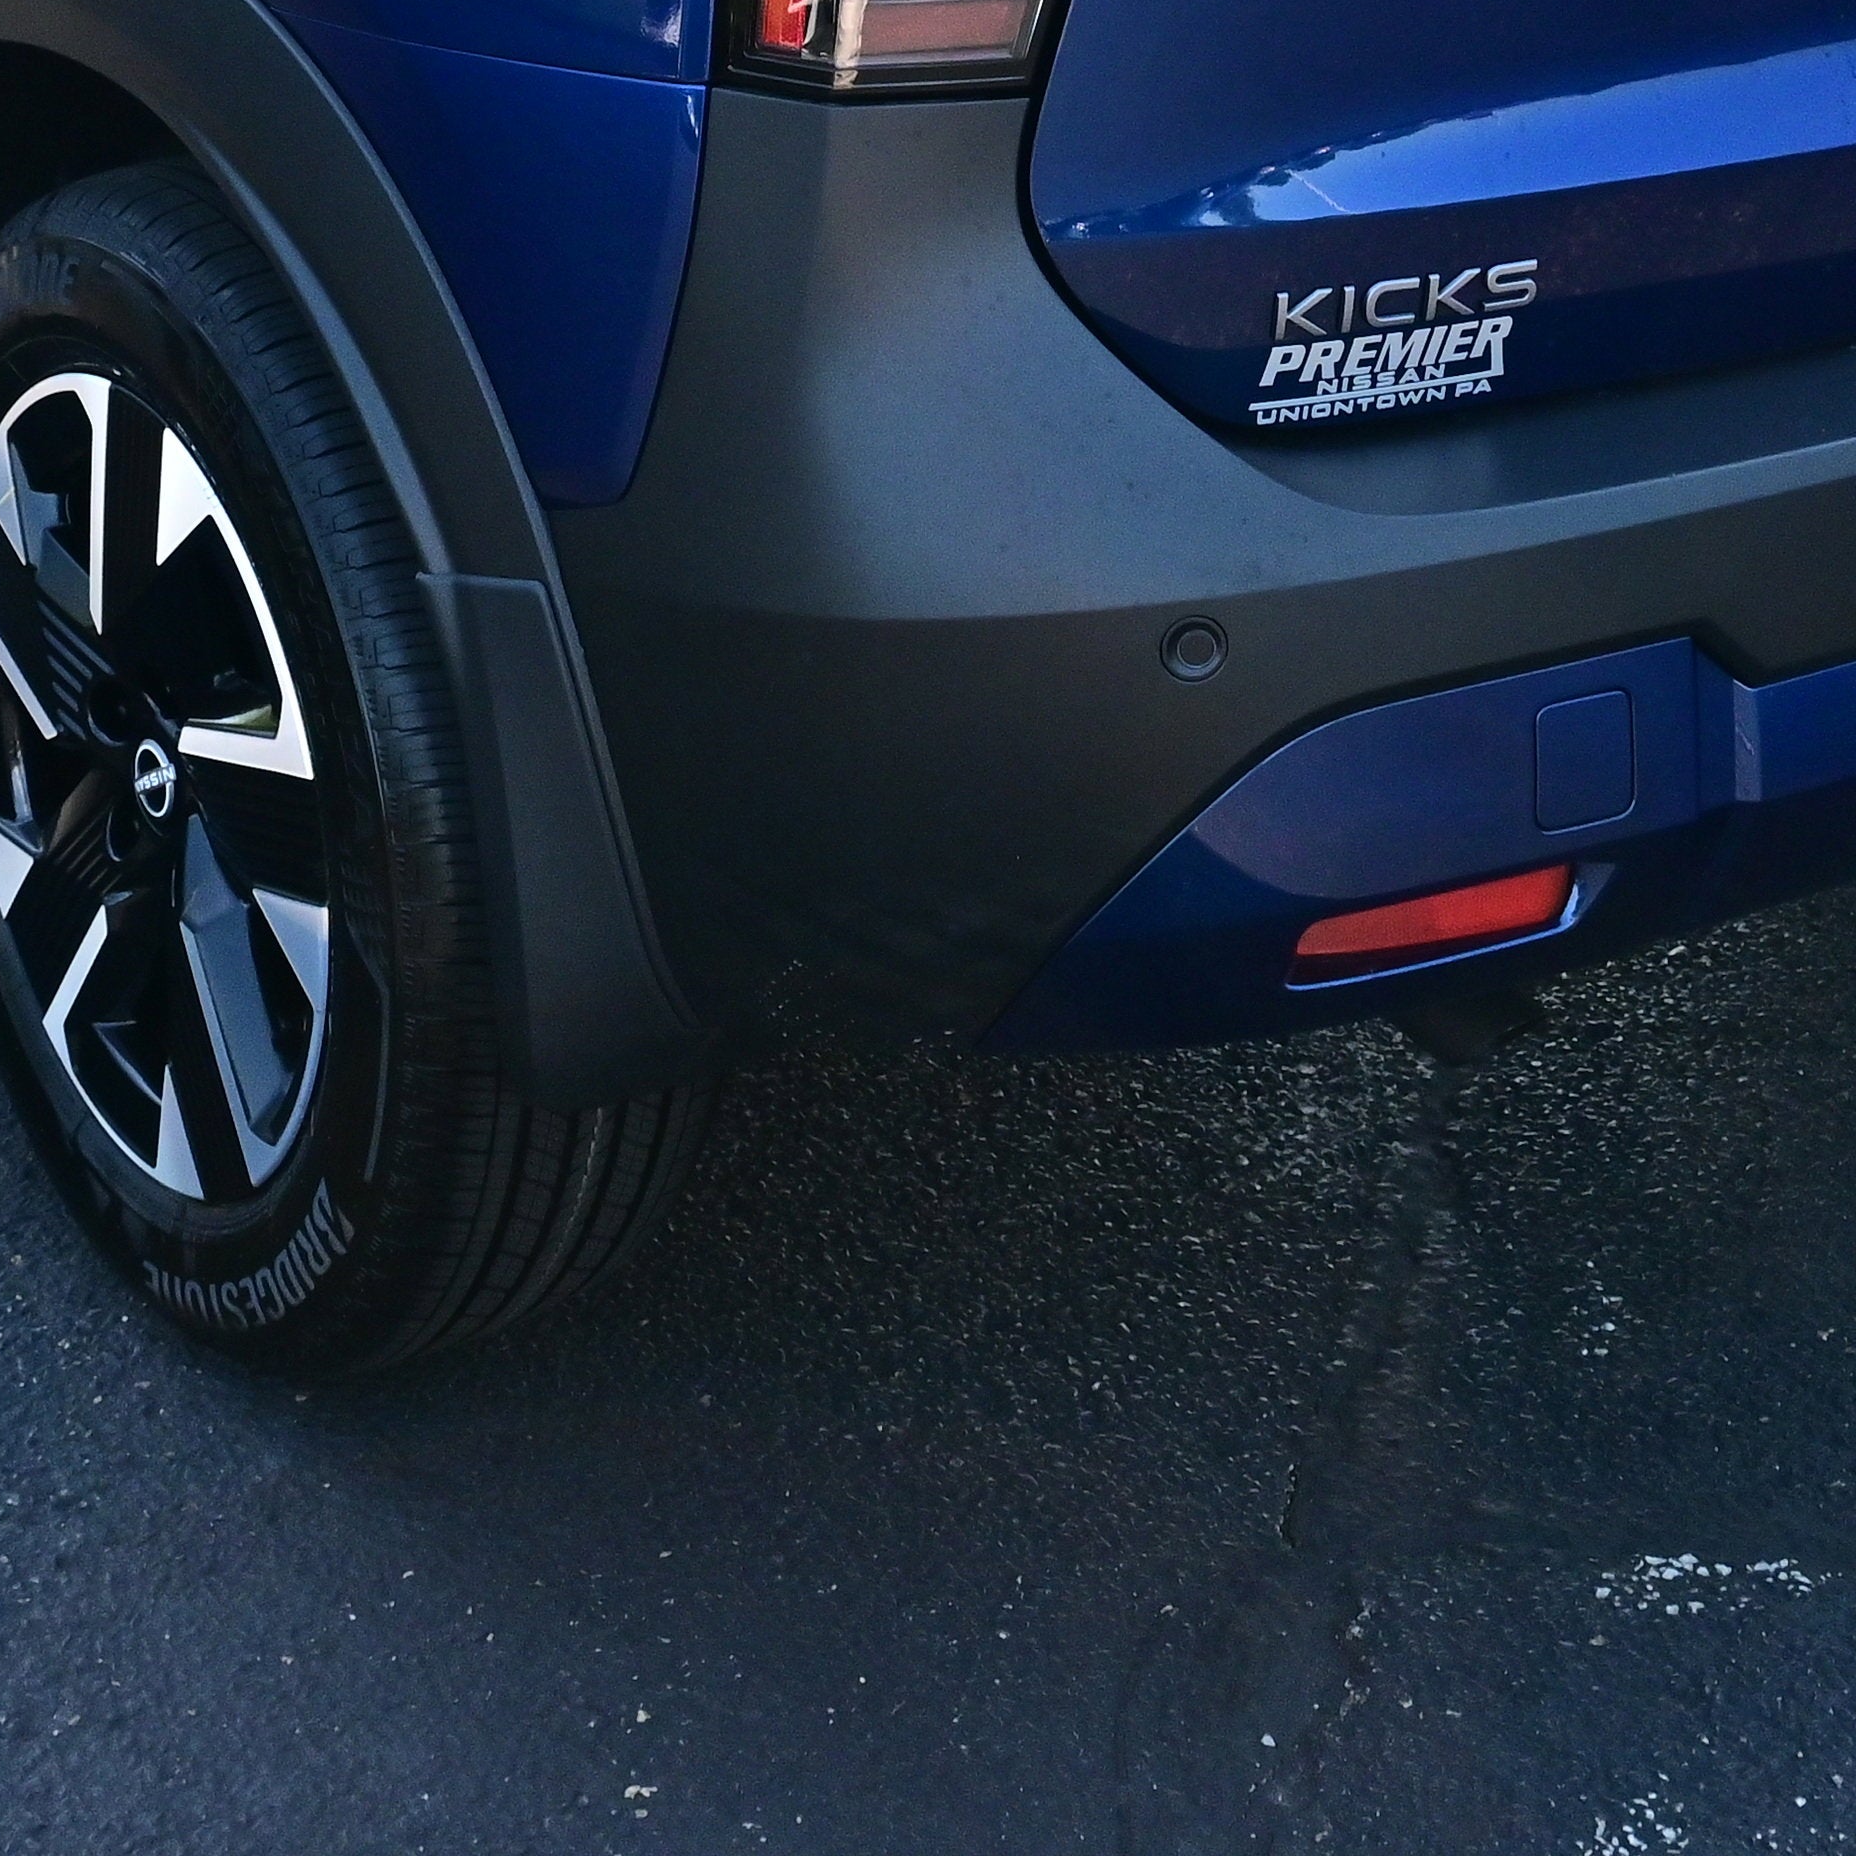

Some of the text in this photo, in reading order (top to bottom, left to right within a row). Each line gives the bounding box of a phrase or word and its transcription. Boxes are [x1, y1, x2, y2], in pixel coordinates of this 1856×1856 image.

[1274, 258, 1538, 341] KICKS
[1258, 315, 1514, 387] PREMIER
[1316, 363, 1446, 396] NISSAN
[1256, 380, 1493, 426] UNIONTOWN PA
